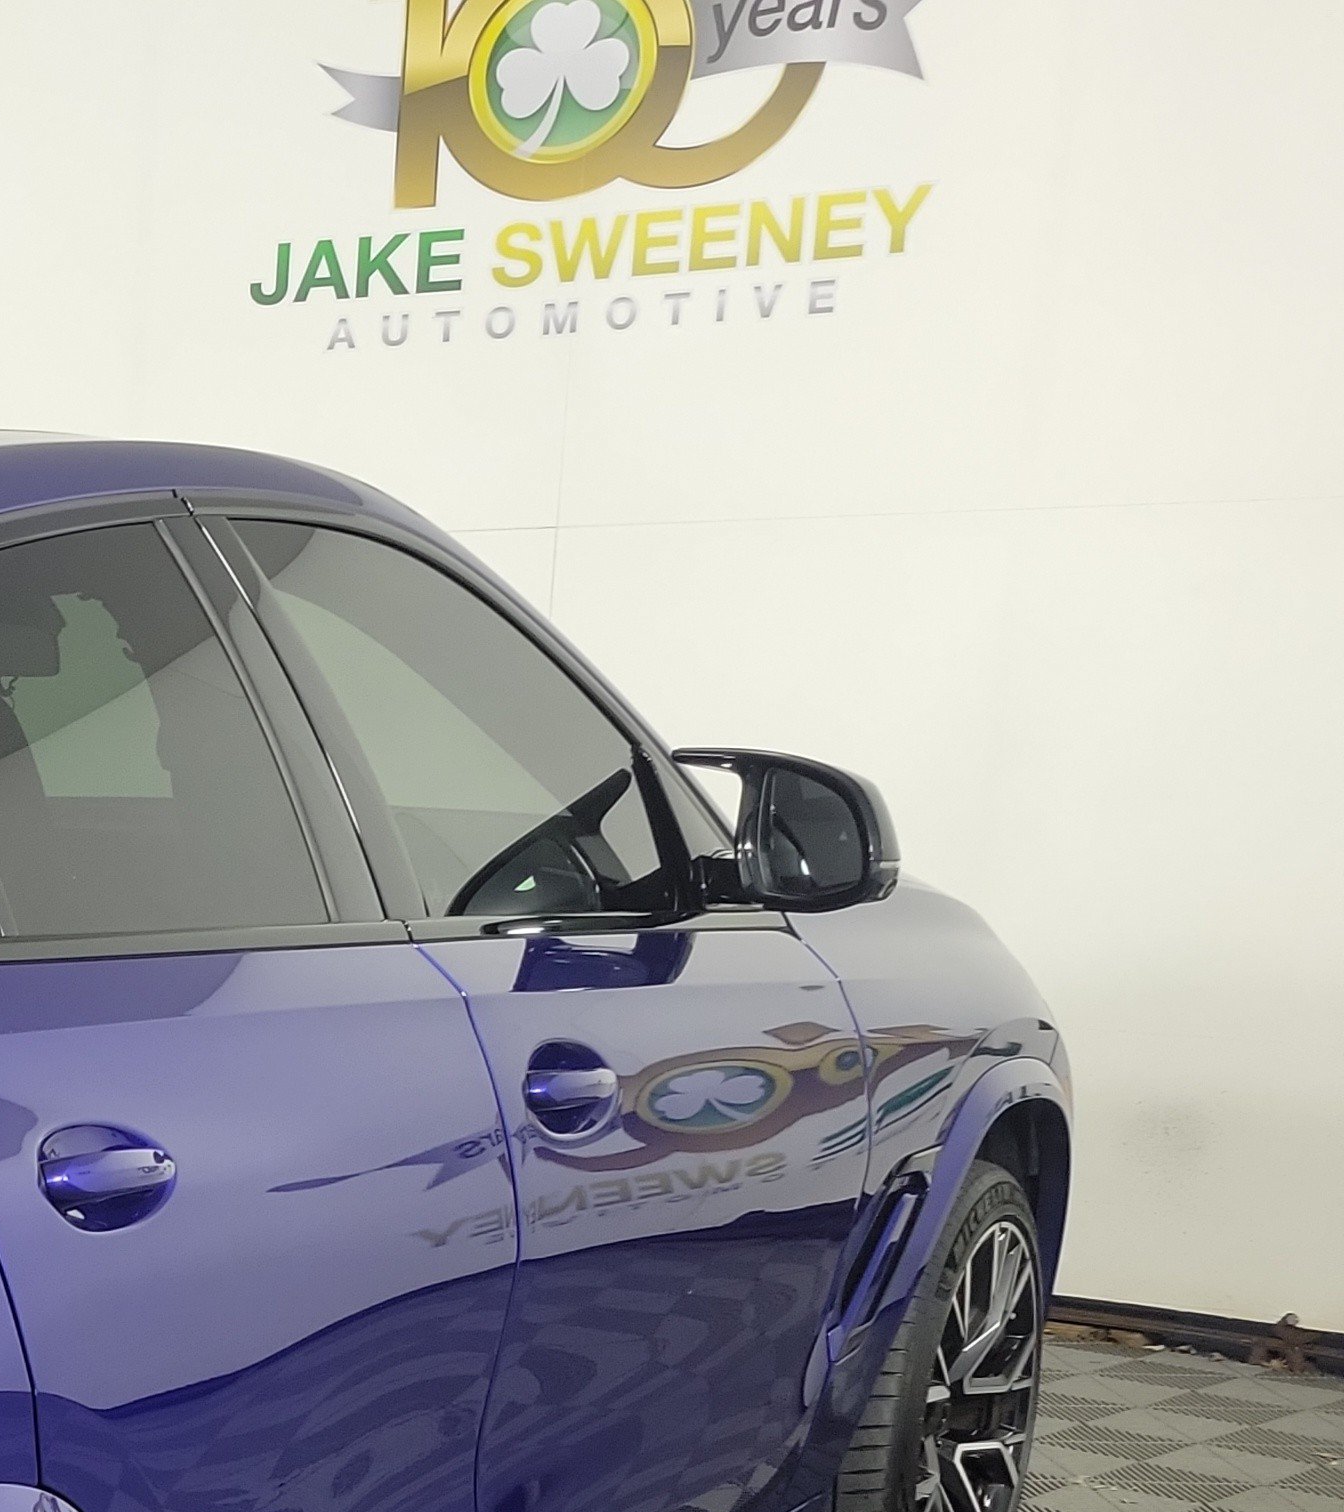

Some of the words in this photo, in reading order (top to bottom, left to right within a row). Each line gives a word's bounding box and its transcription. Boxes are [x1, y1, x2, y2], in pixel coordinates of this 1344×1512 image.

[250, 228, 466, 306] JAKE
[491, 184, 935, 289] SWEENEY
[326, 279, 838, 350] AUTOMOTIVE
